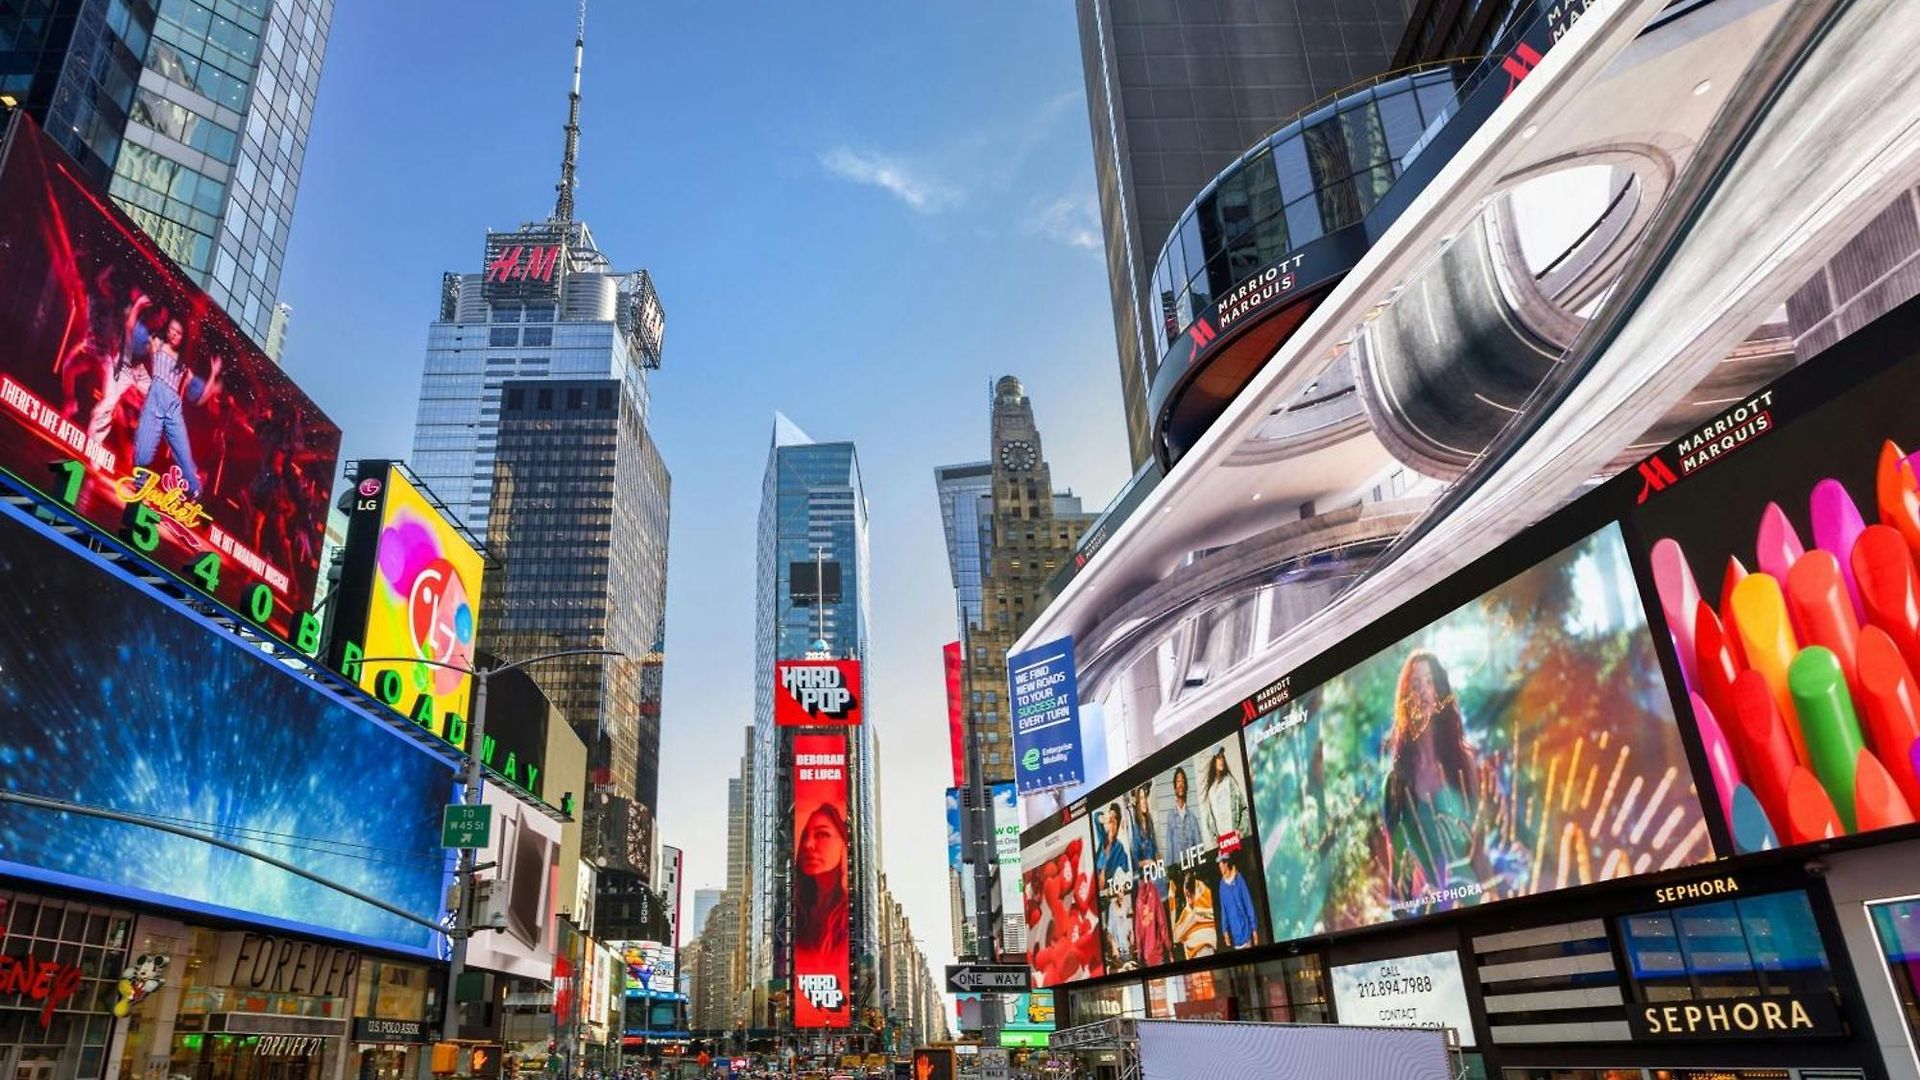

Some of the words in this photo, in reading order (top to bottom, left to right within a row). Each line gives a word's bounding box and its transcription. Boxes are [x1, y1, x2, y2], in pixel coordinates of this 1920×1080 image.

[488, 245, 560, 283] H&M
[1218, 253, 1305, 314] MARRIOTT
[1220, 276, 1293, 328] MARQUIS
[0, 378, 40, 420] THERE'S
[39, 405, 60, 433] LIFE
[57, 419, 86, 453] AFTER
[1678, 391, 1772, 456] MARRIOTT
[1684, 416, 1768, 472] MARQUIS
[357, 499, 377, 511] LG
[779, 666, 840, 700] HARD
[1015, 672, 1029, 684] WE
[1030, 666, 1049, 680] FIND
[1016, 681, 1035, 695] NEW
[1037, 671, 1065, 689] ROADS
[800, 688, 851, 713] POP
[1017, 695, 1029, 706] TO
[1030, 688, 1053, 703] YOUR
[1257, 676, 1291, 702] MARRIOTT
[1018, 698, 1056, 717] SUCCESS
[1057, 694, 1069, 706] AT
[1258, 690, 1289, 713] MARQUIS
[1019, 713, 1045, 729] EVERY
[1047, 706, 1070, 720] TURN
[796, 754, 844, 766] DEBORAH
[800, 769, 814, 780] DE
[815, 769, 841, 780] LUCA
[463, 809, 475, 818] TO
[1107, 869, 1132, 896] TOS
[1143, 860, 1166, 884] FOR
[1180, 843, 1206, 871] LIFE
[1431, 883, 1482, 904] SEPHORA
[1656, 877, 1739, 903] SEPHORA
[230, 932, 357, 997] FOREVER
[1380, 966, 1401, 978] CALL
[797, 974, 837, 1000] HARD
[959, 974, 983, 985] ONE
[995, 974, 1020, 985] WAY
[1358, 975, 1432, 998] 212.894.7988
[810, 989, 843, 1008] POP
[1379, 1008, 1417, 1020] CONTACT
[1645, 1001, 1813, 1033] SEPHORA
[255, 1036, 307, 1057] FOREVER
[307, 1038, 322, 1056] 21
